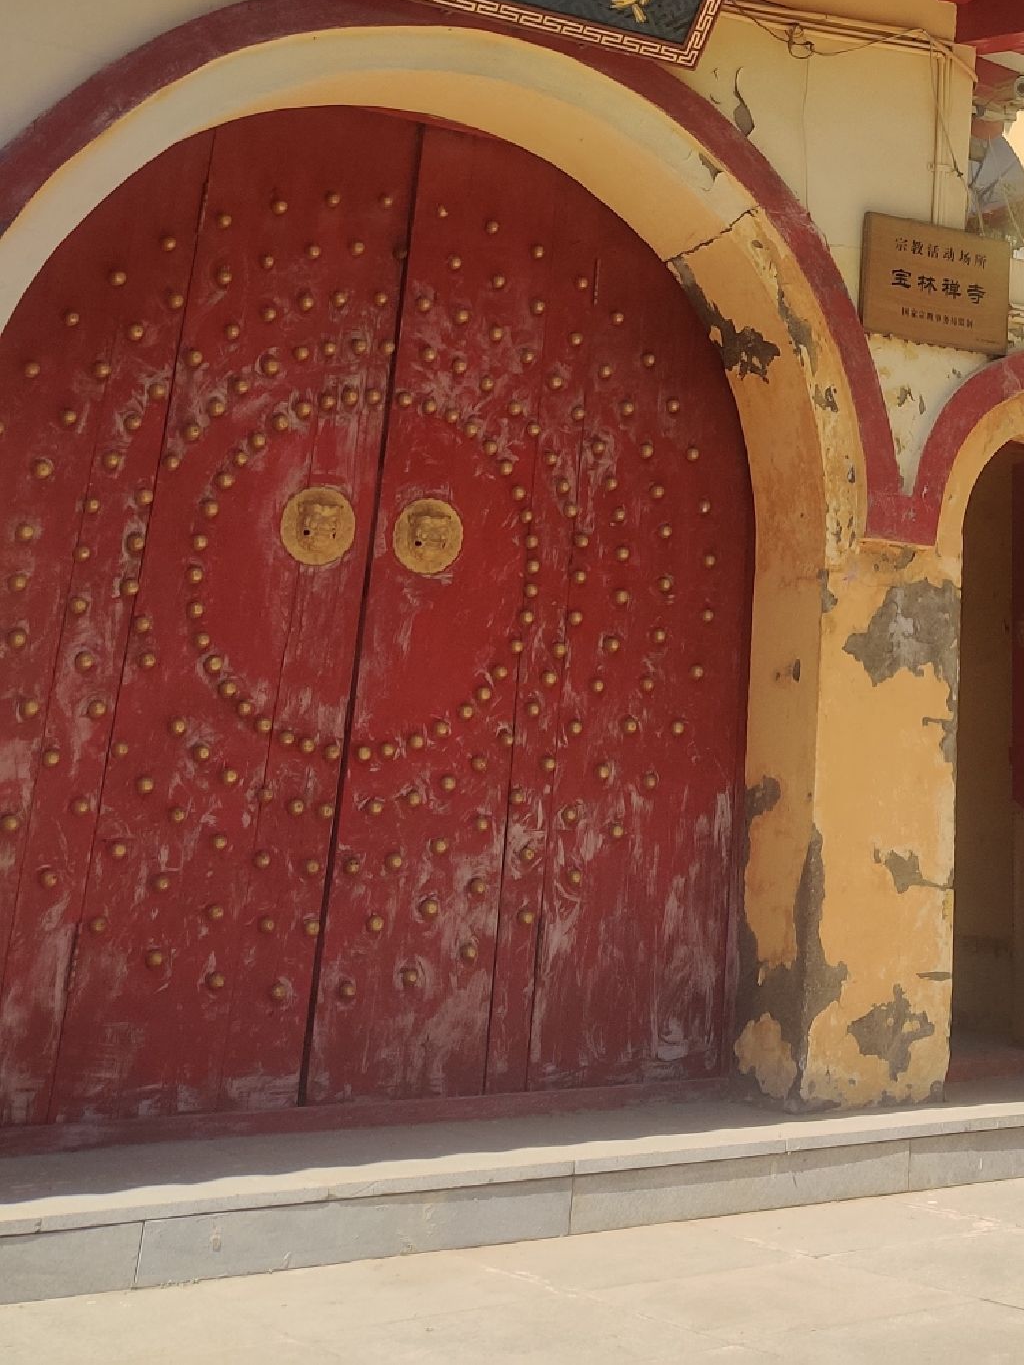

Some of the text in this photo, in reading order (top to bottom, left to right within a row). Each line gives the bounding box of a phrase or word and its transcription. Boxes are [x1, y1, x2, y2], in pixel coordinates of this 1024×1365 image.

[895, 237, 987, 270] 宗教活动场所
[891, 268, 987, 304] 宝林禅寺
